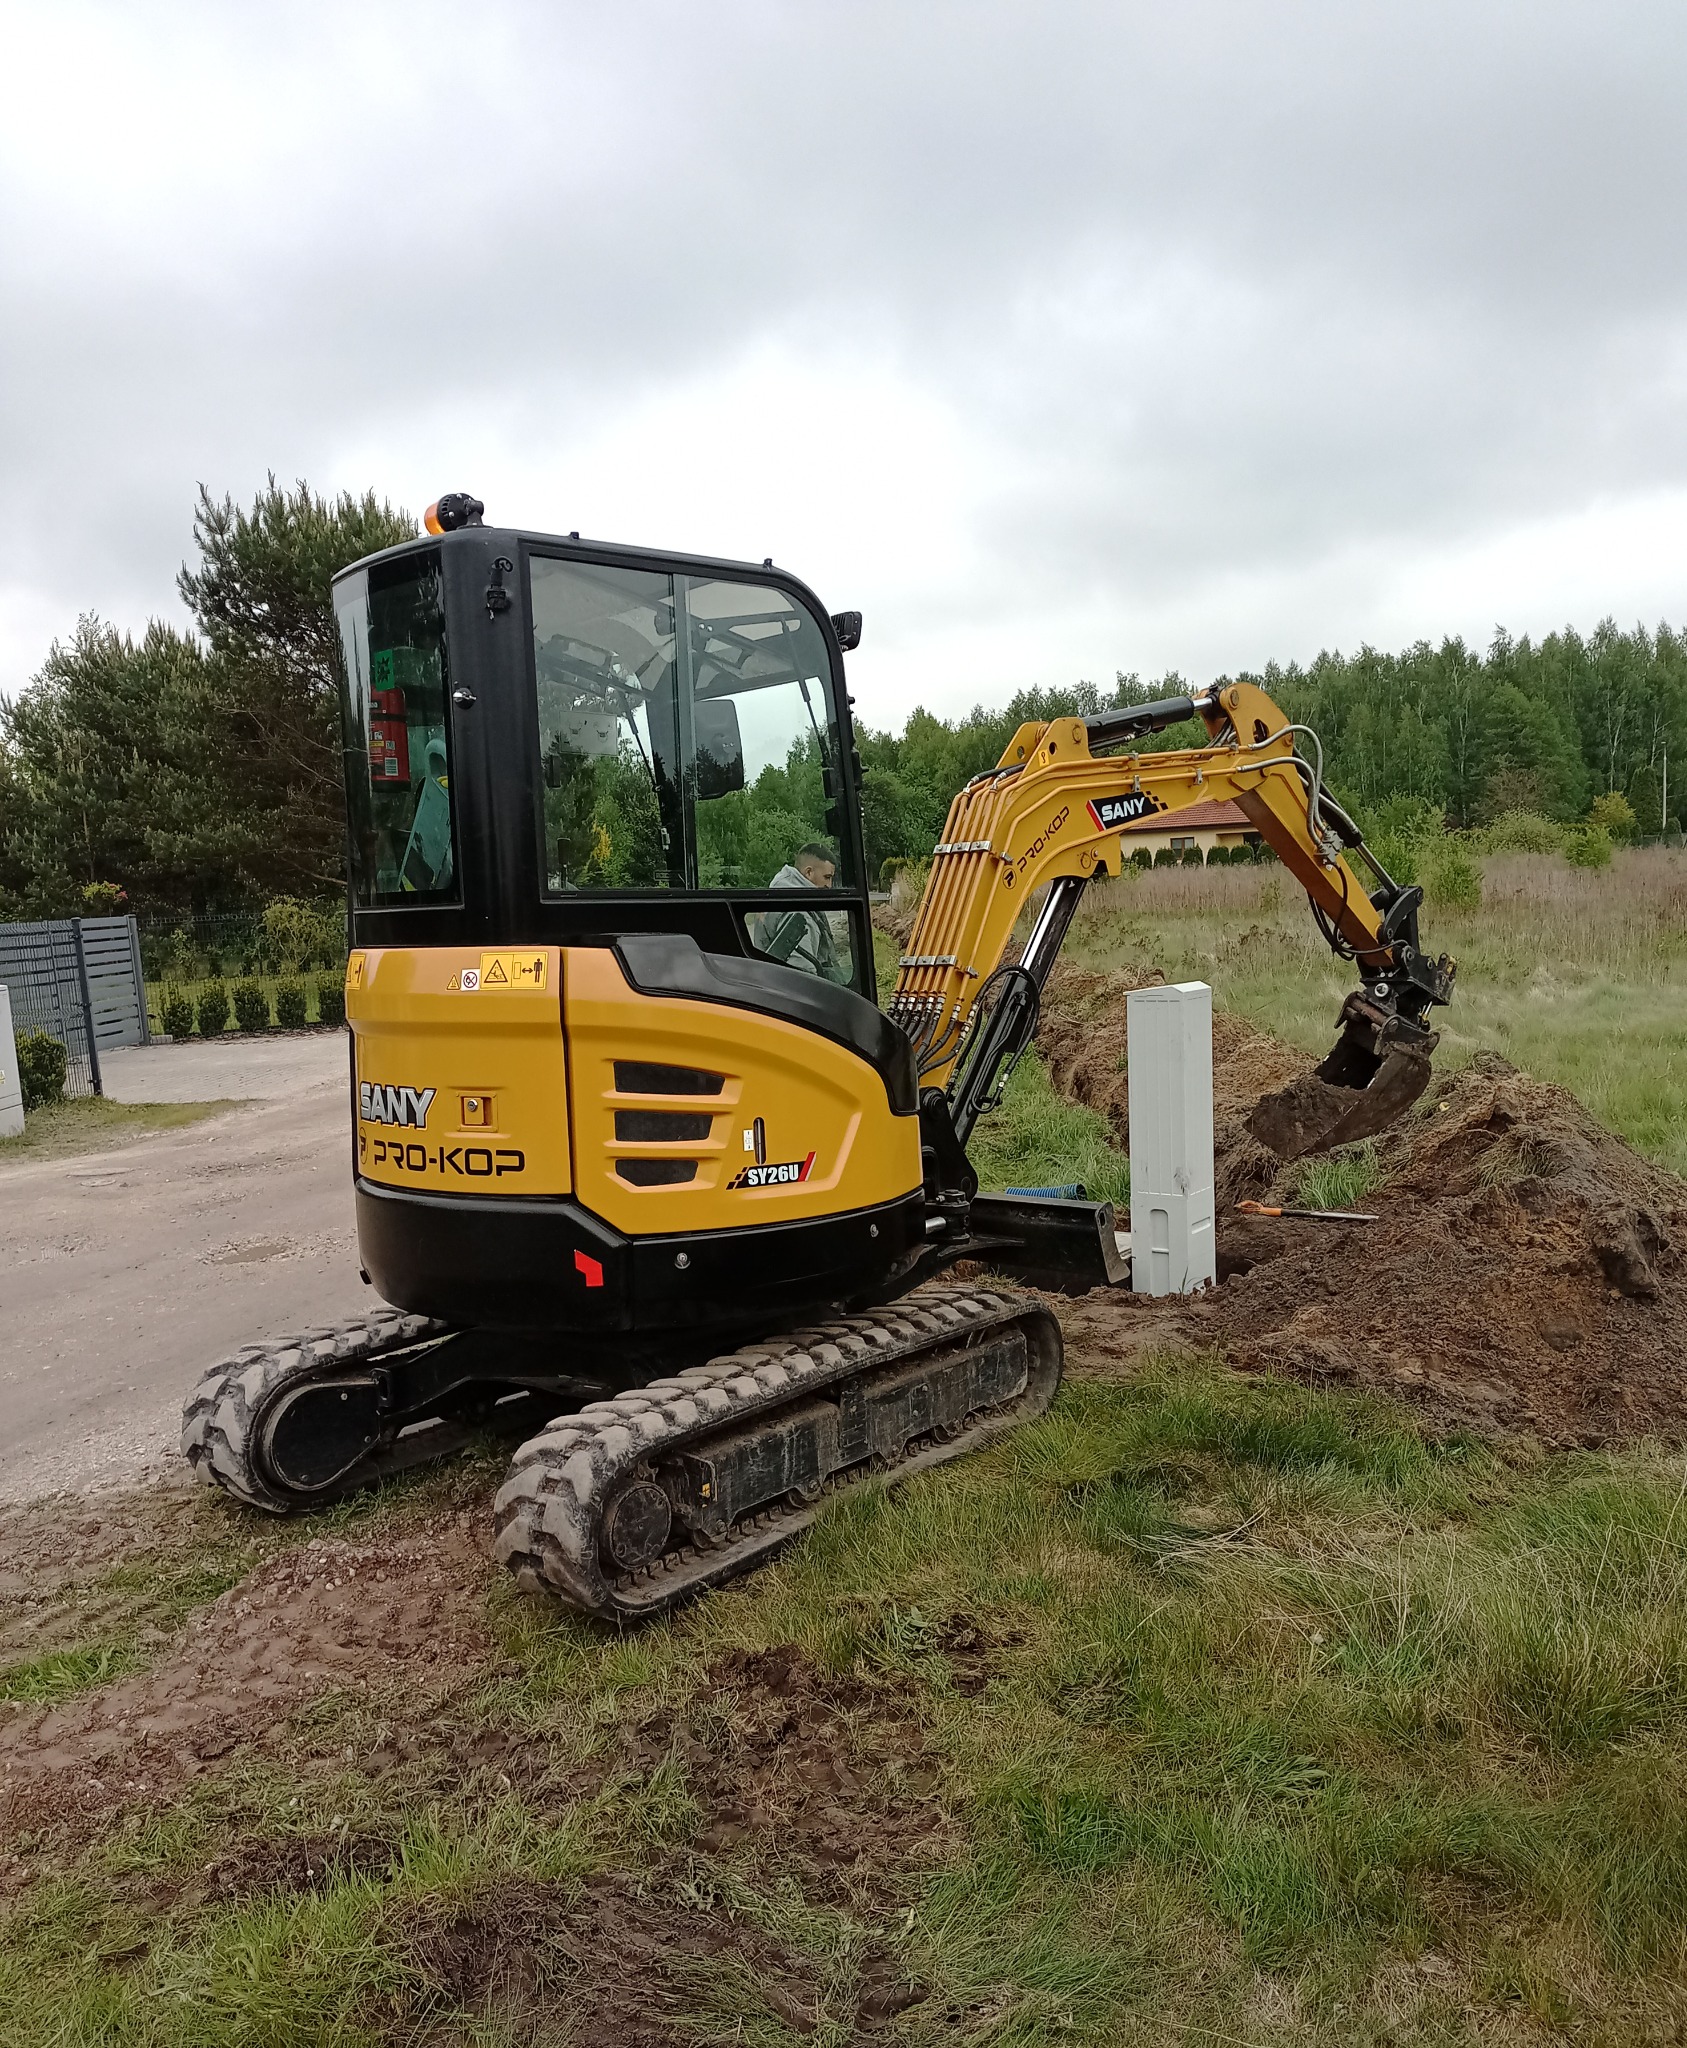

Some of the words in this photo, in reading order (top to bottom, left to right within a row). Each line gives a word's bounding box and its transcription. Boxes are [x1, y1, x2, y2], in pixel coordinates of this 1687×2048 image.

[1102, 797, 1145, 822] SANY
[1017, 806, 1070, 873] PRO-KOP
[360, 1082, 436, 1128] SANY
[374, 1140, 525, 1176] PRO-KOP
[747, 1164, 799, 1186] SY26U
